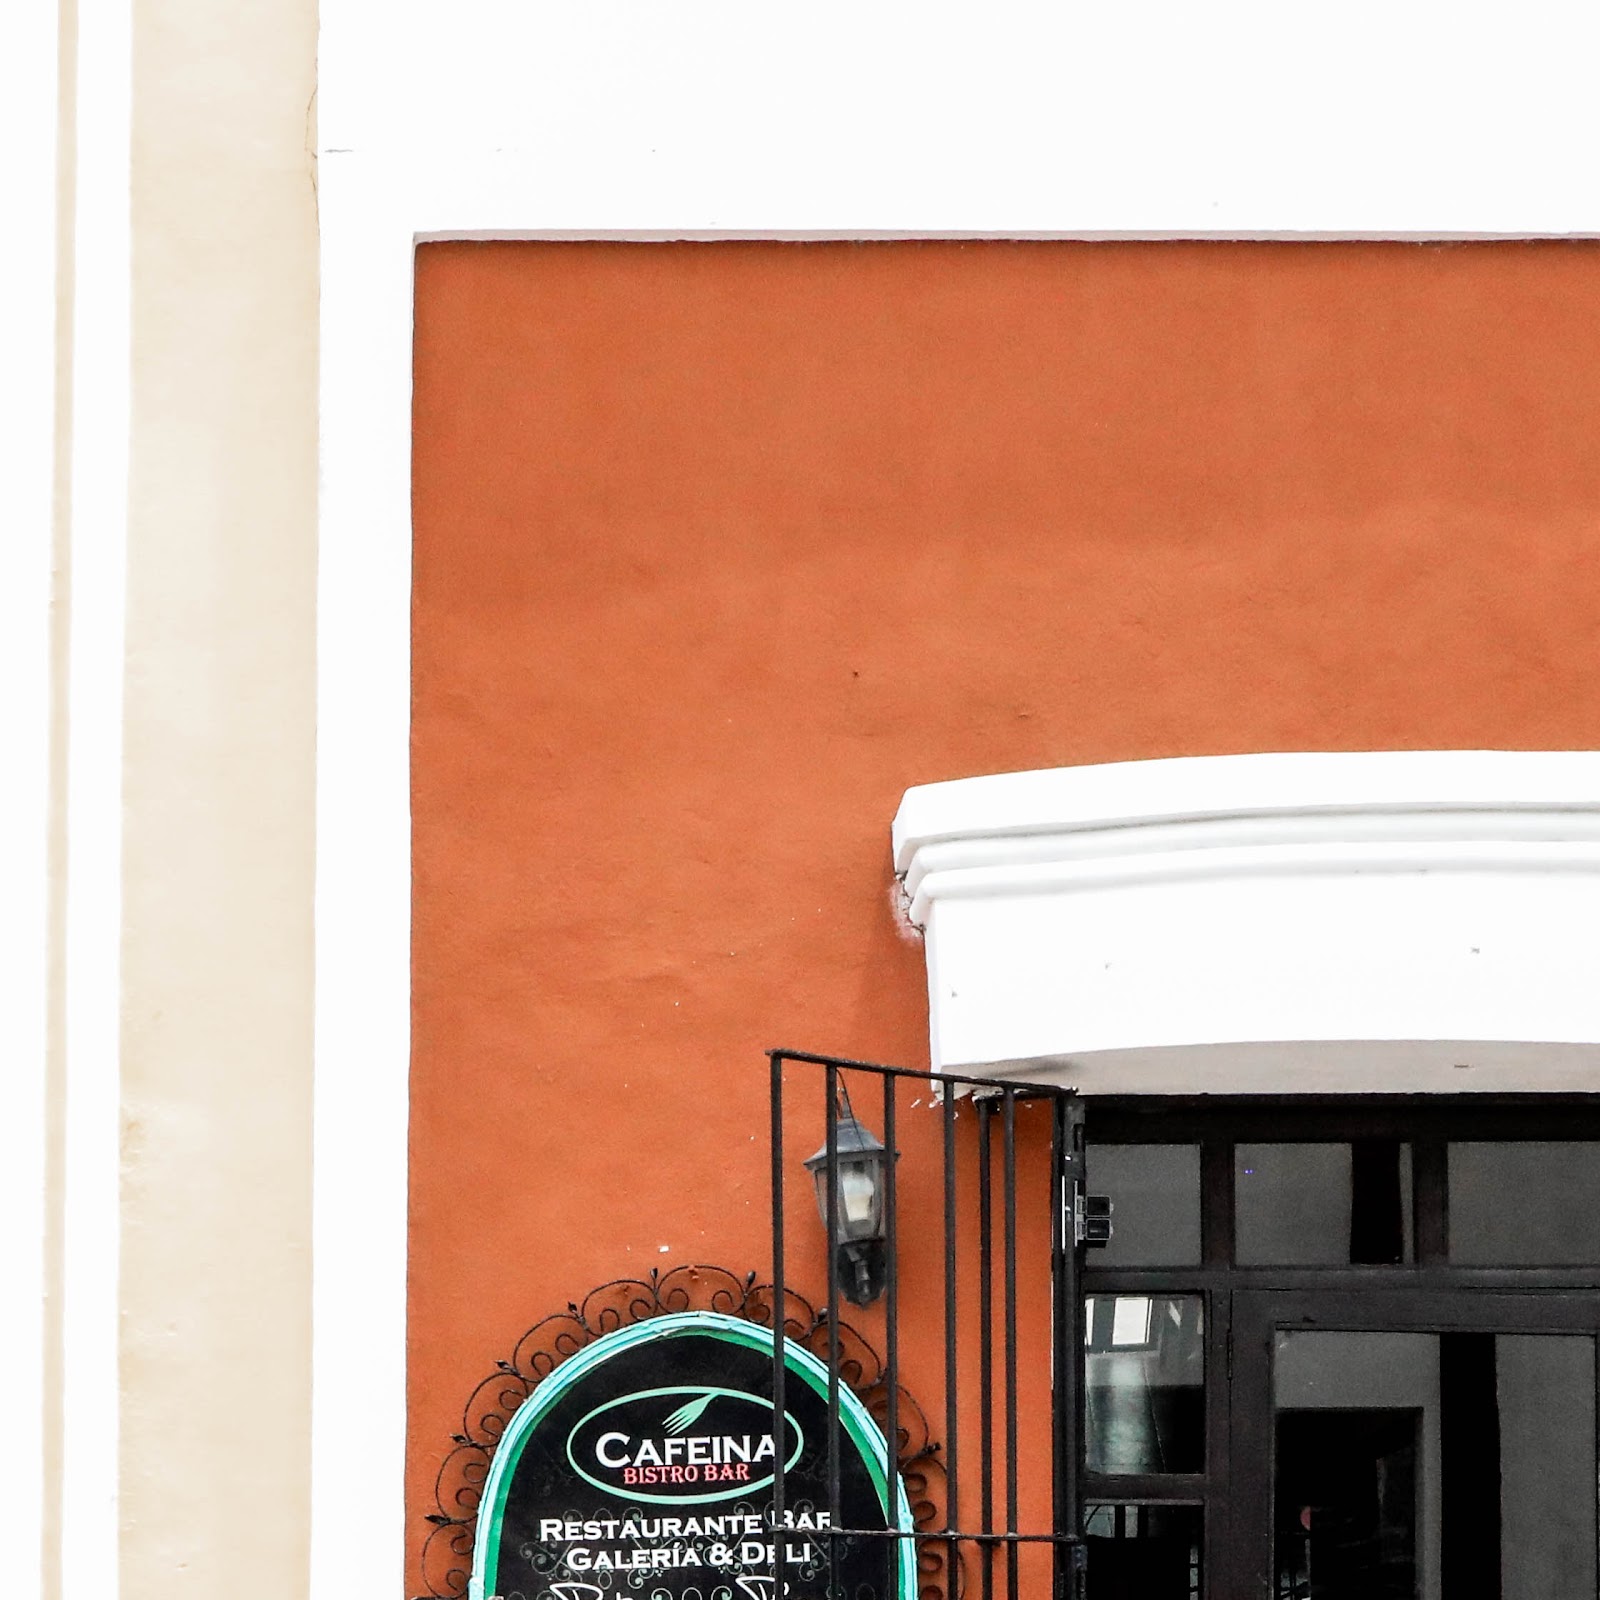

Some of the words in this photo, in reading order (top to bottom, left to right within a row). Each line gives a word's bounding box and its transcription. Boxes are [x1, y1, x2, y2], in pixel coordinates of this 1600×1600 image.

[595, 1431, 776, 1469] CAFEINA
[623, 1465, 699, 1485] BISTRO
[704, 1463, 751, 1482] BAR
[540, 1514, 763, 1542] RESTAURANTE
[709, 1543, 733, 1566] &
